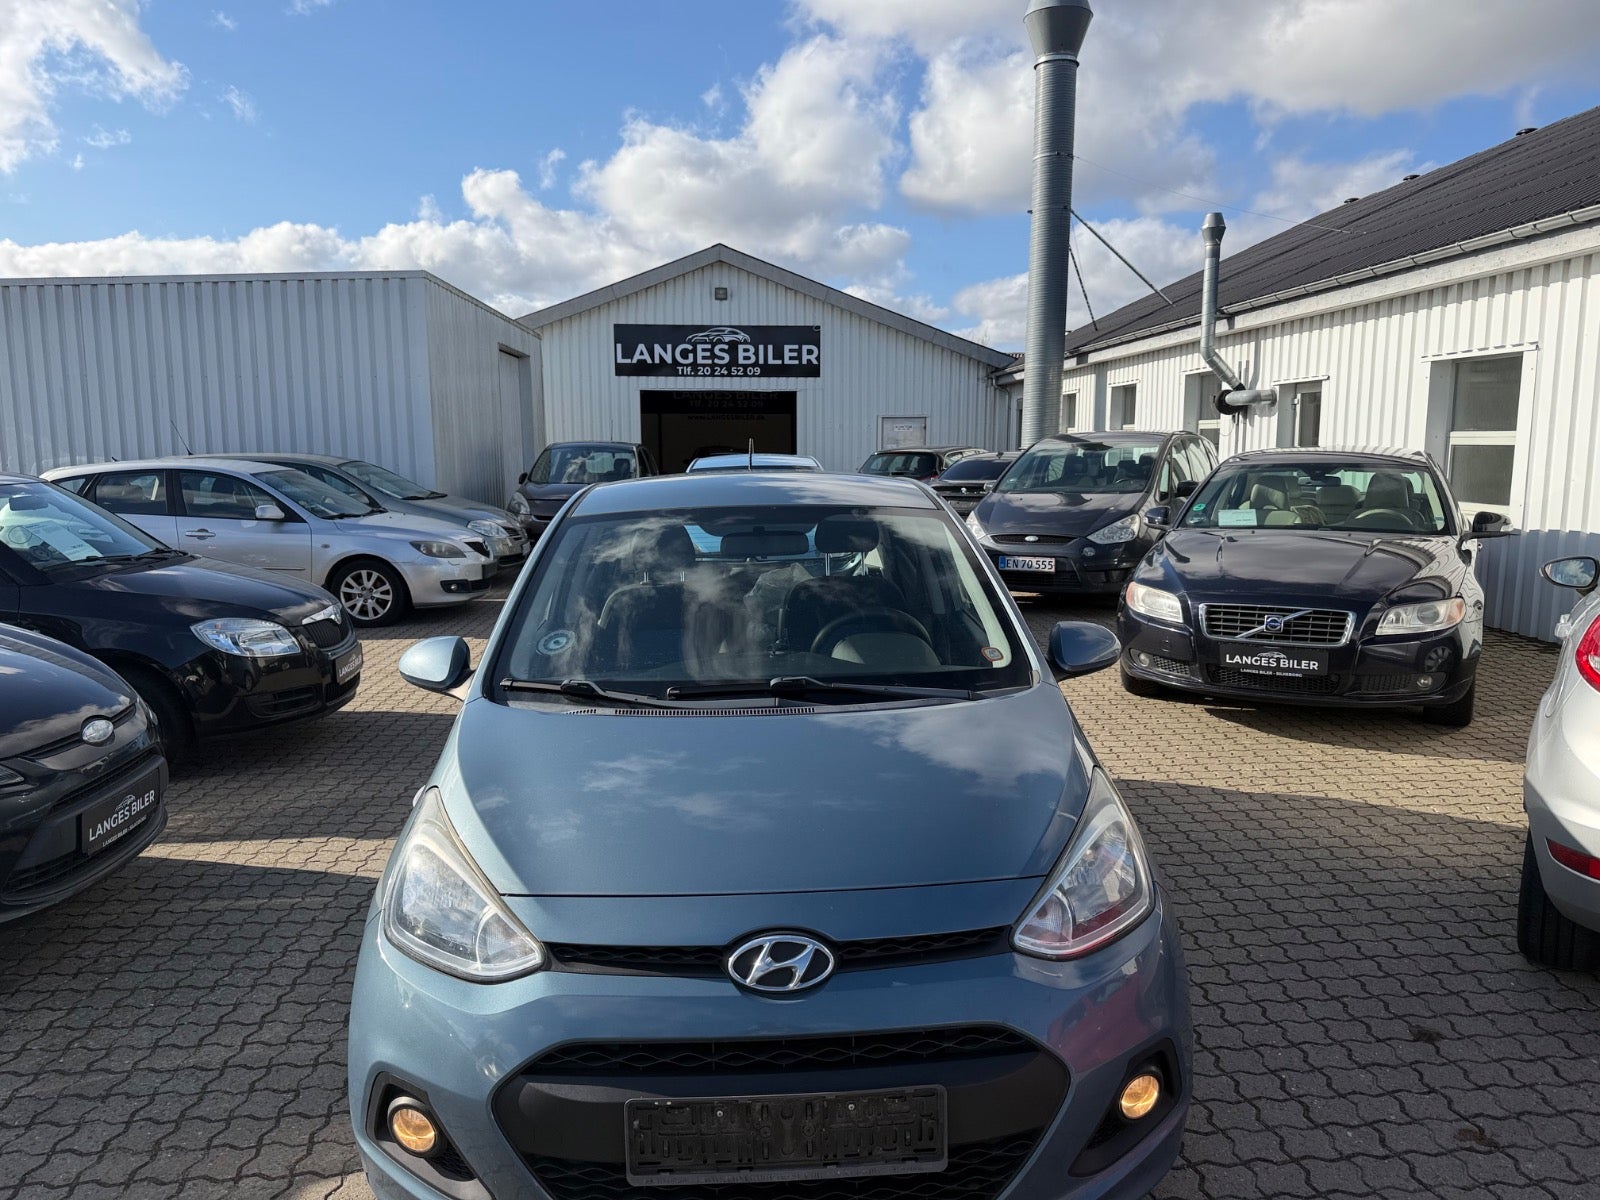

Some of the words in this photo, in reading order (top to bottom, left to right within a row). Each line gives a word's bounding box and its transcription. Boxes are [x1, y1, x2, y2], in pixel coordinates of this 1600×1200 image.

[616, 343, 730, 365] LANGES
[738, 344, 819, 365] BILER
[676, 366, 694, 375] Tlf.
[697, 366, 711, 375] 20
[714, 366, 728, 375] 24
[731, 367, 744, 375] 52
[747, 367, 761, 375] 09
[1006, 559, 1019, 568] EN
[1021, 559, 1033, 569] 70
[1035, 560, 1053, 570] 555
[1226, 654, 1277, 667] LANGES
[1280, 659, 1318, 670] BILER
[89, 806, 130, 842] LANGES
[131, 789, 155, 816] BILER
